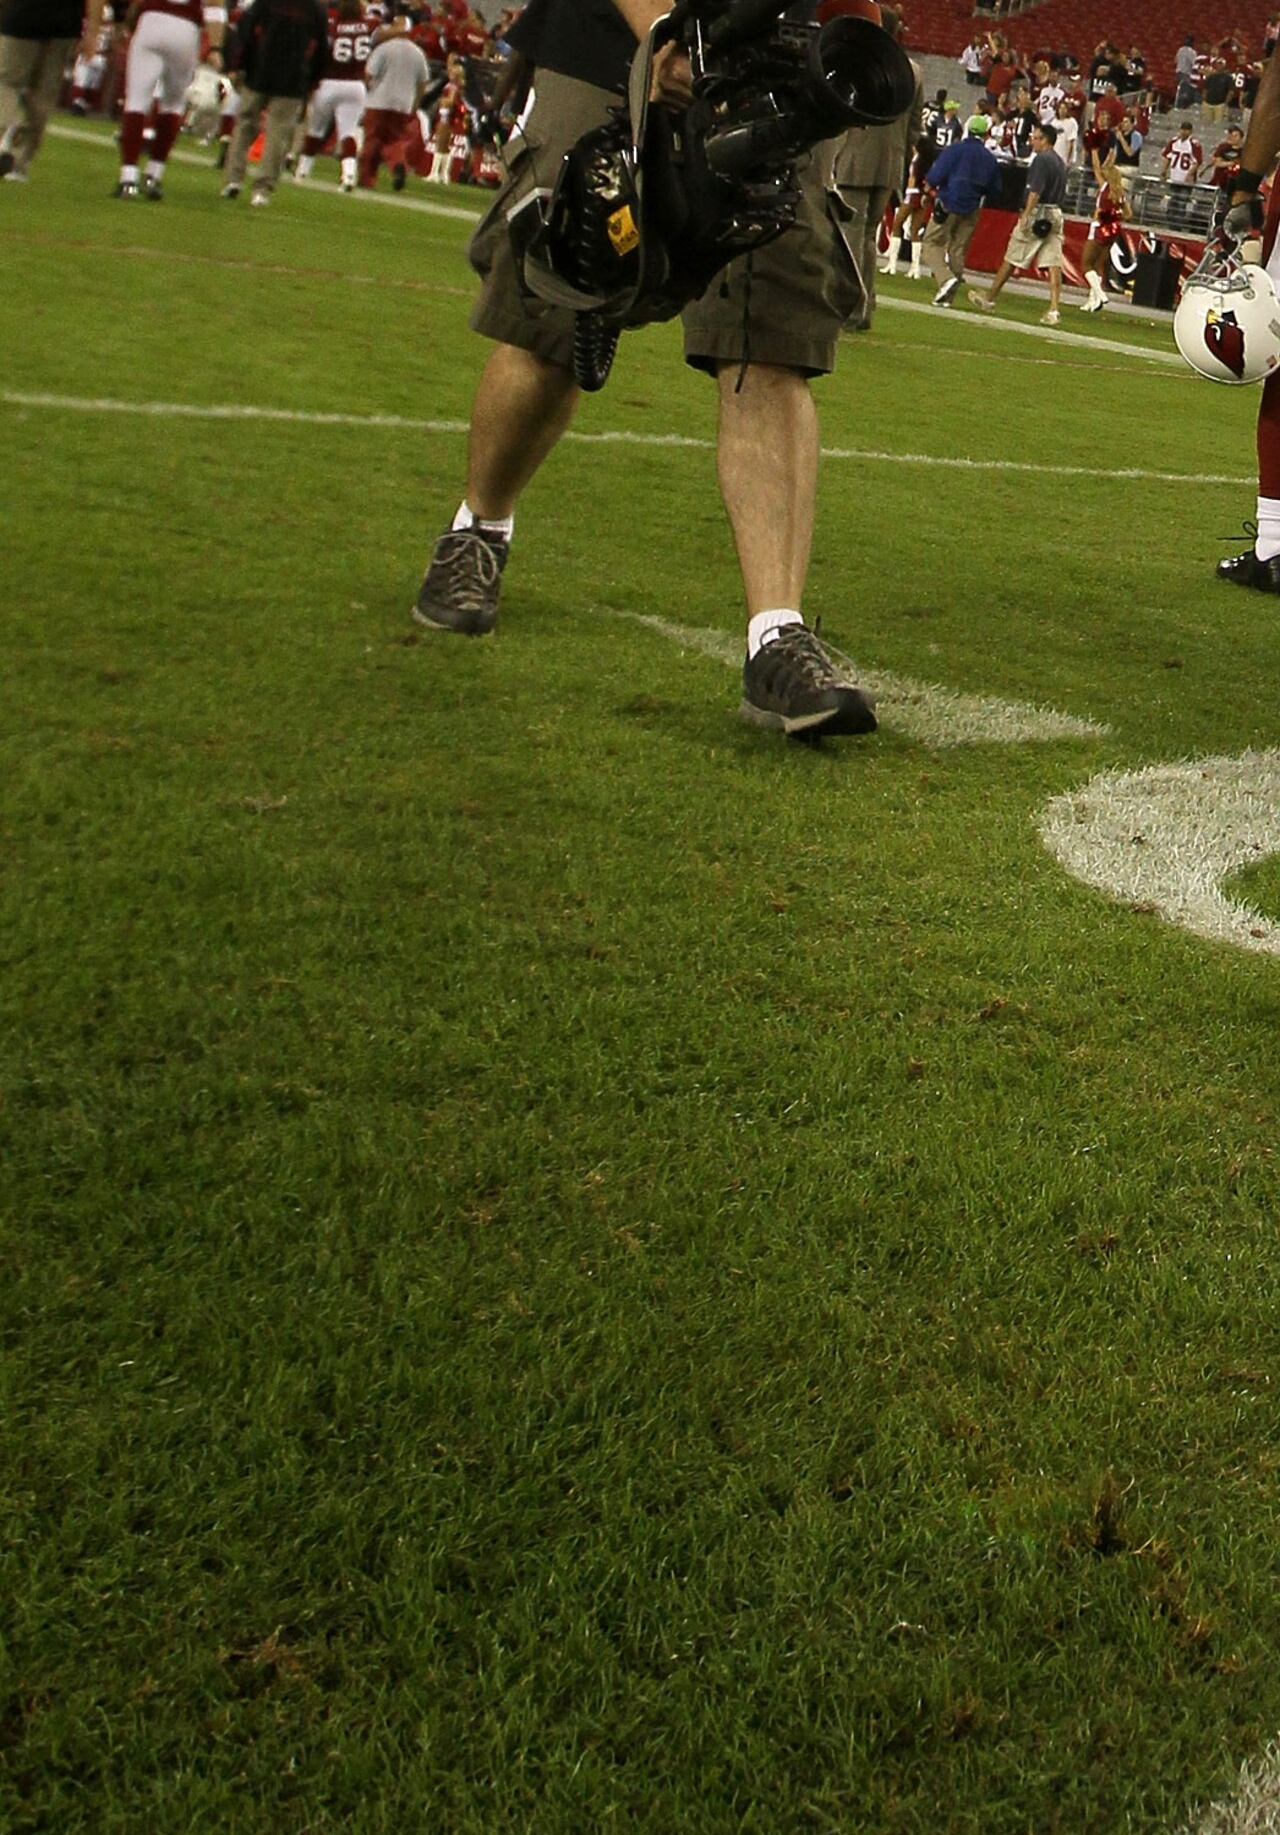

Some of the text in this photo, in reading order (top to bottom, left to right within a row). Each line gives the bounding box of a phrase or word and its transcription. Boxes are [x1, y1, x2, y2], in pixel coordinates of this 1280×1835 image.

[333, 36, 370, 62] 66
[936, 127, 953, 147] 51
[1170, 150, 1191, 171] 76
